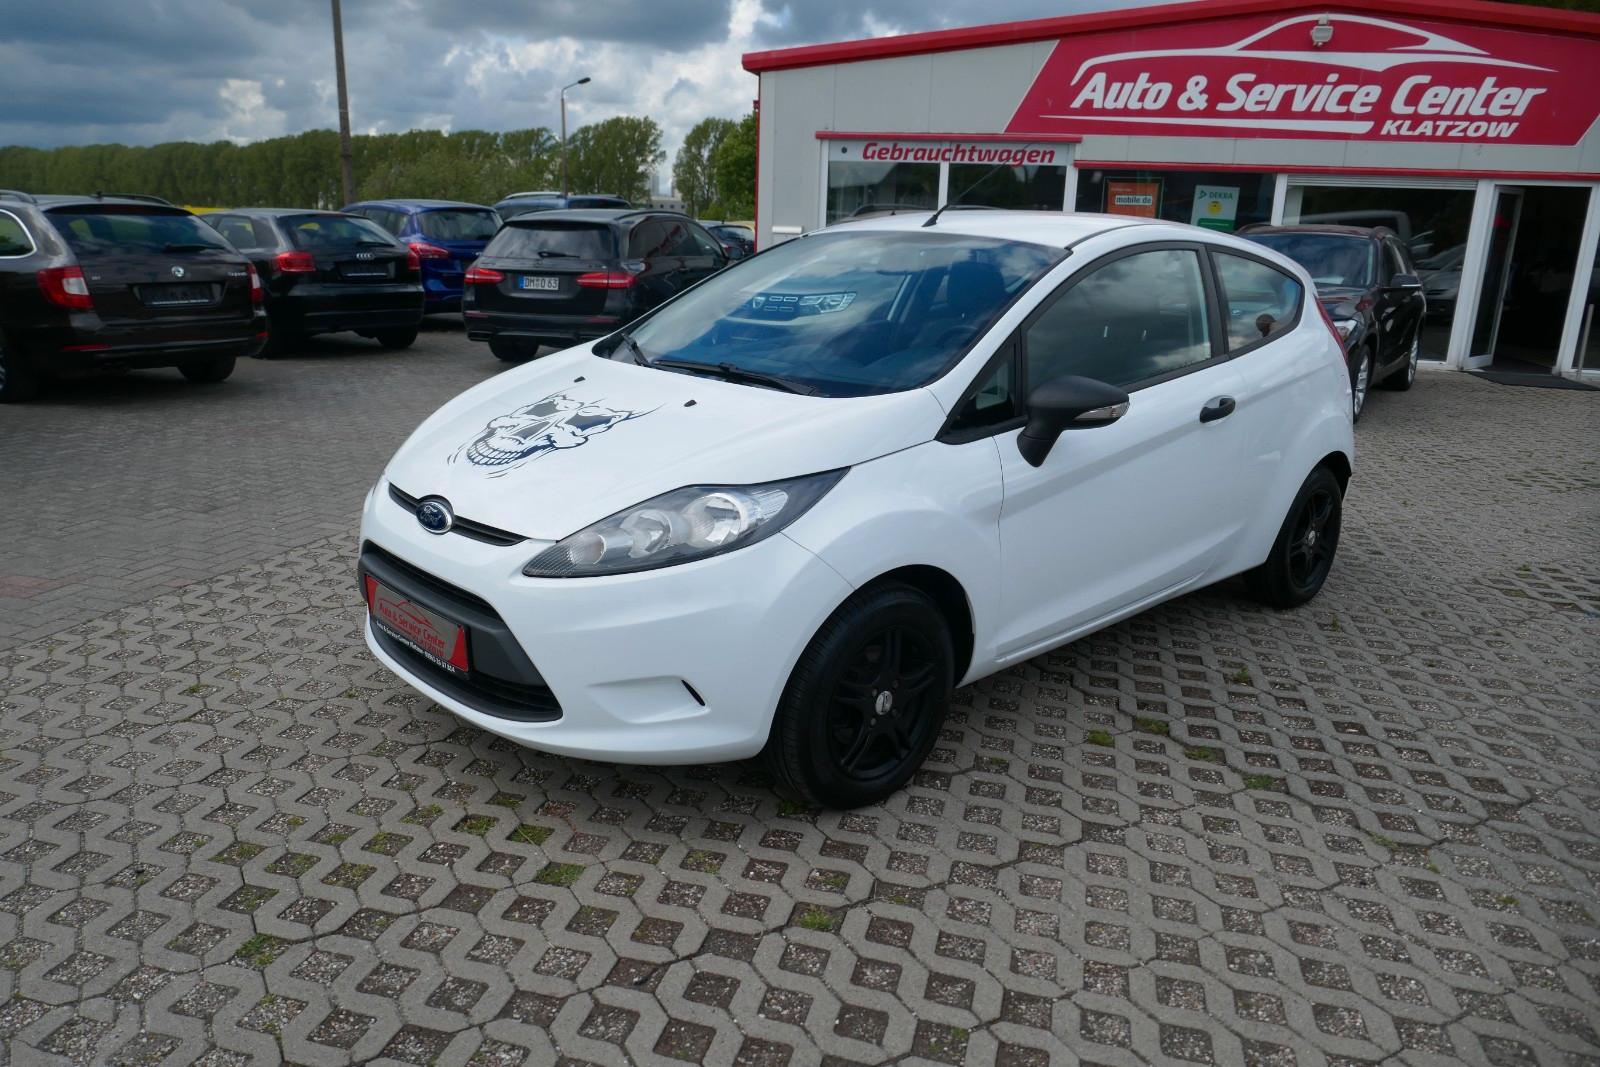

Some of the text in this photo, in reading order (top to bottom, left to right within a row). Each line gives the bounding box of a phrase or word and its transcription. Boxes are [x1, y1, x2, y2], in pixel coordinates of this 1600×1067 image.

[1070, 72, 1547, 116] Auto & Service Center
[1380, 120, 1519, 138] KLATZOW
[862, 142, 1055, 168] Gebrauchtwagen
